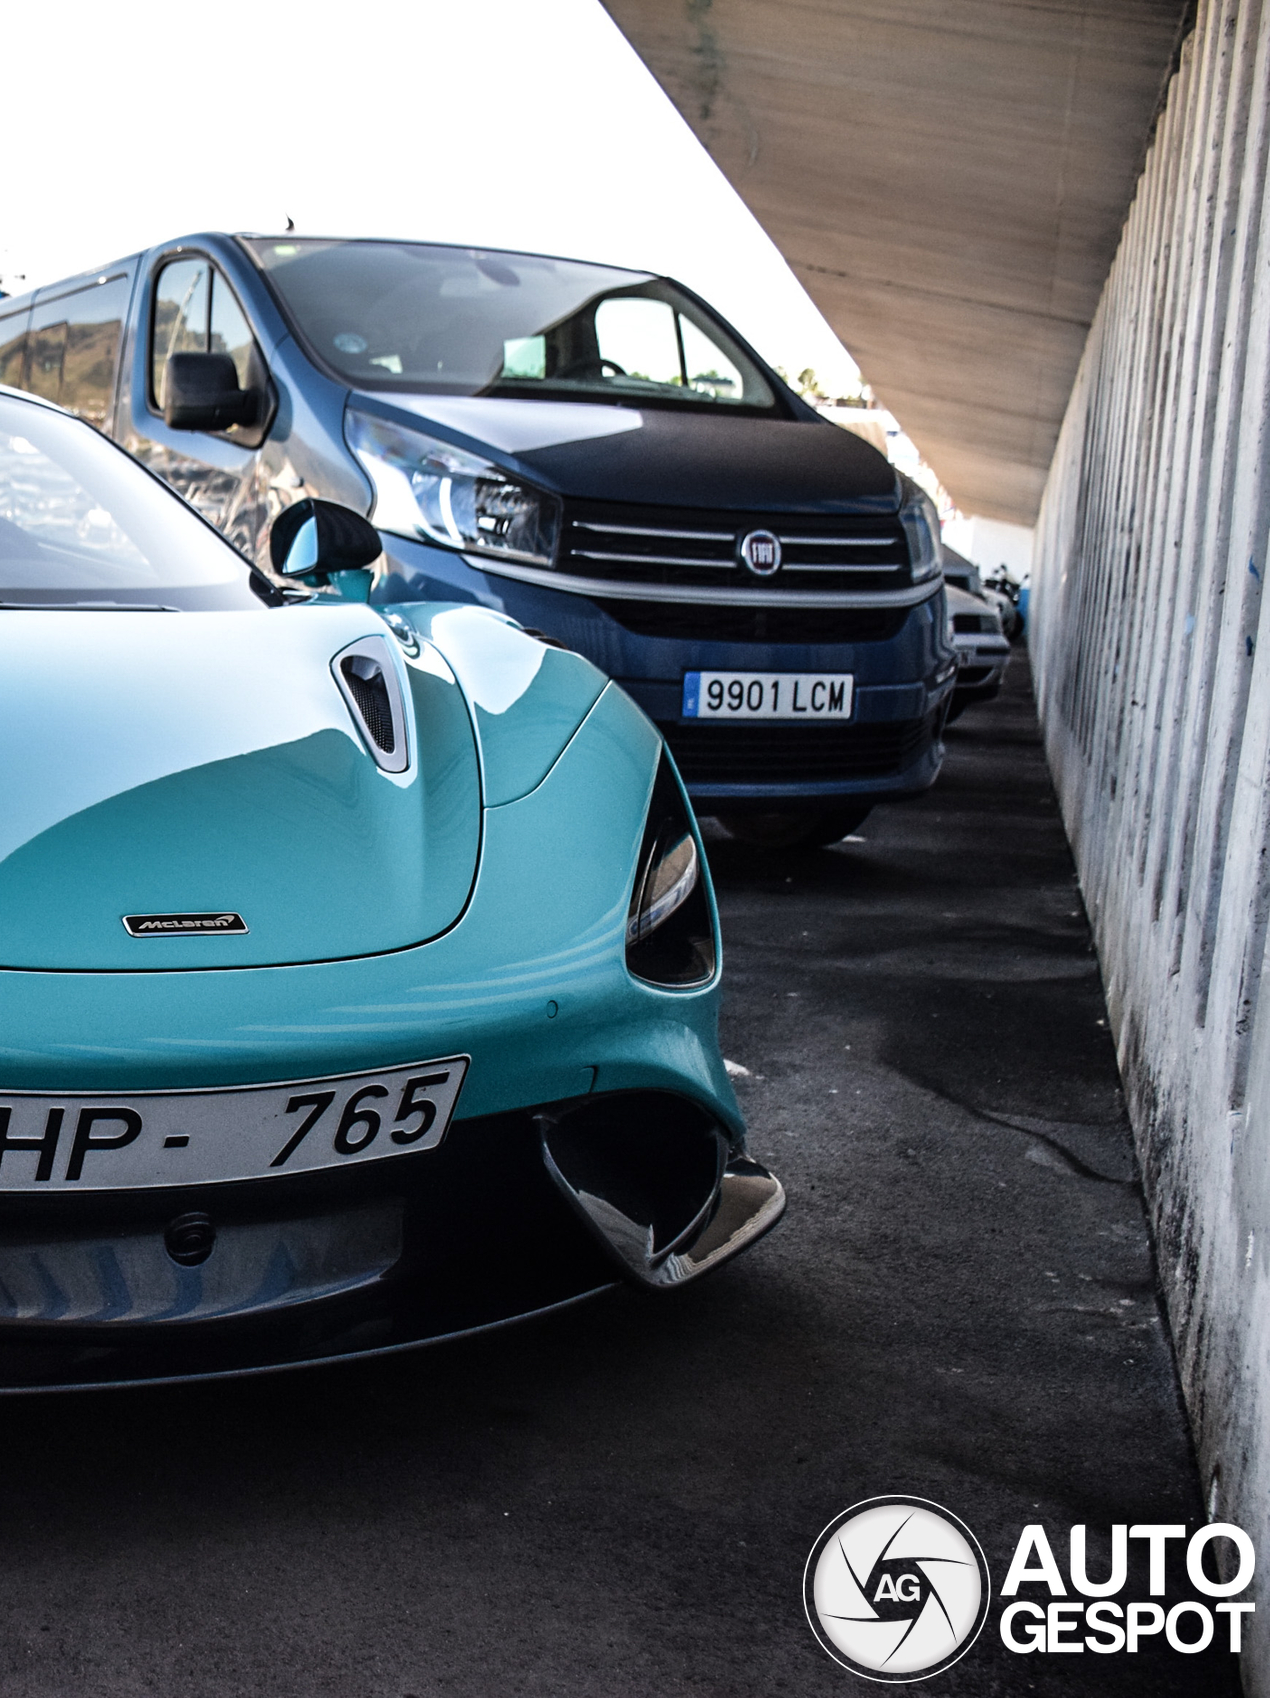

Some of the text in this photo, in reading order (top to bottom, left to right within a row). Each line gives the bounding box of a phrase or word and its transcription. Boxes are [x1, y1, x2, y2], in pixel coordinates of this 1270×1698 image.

[707, 679, 845, 712] 9901 LCM
[138, 918, 230, 930] McLaren
[269, 1071, 451, 1167] 765
